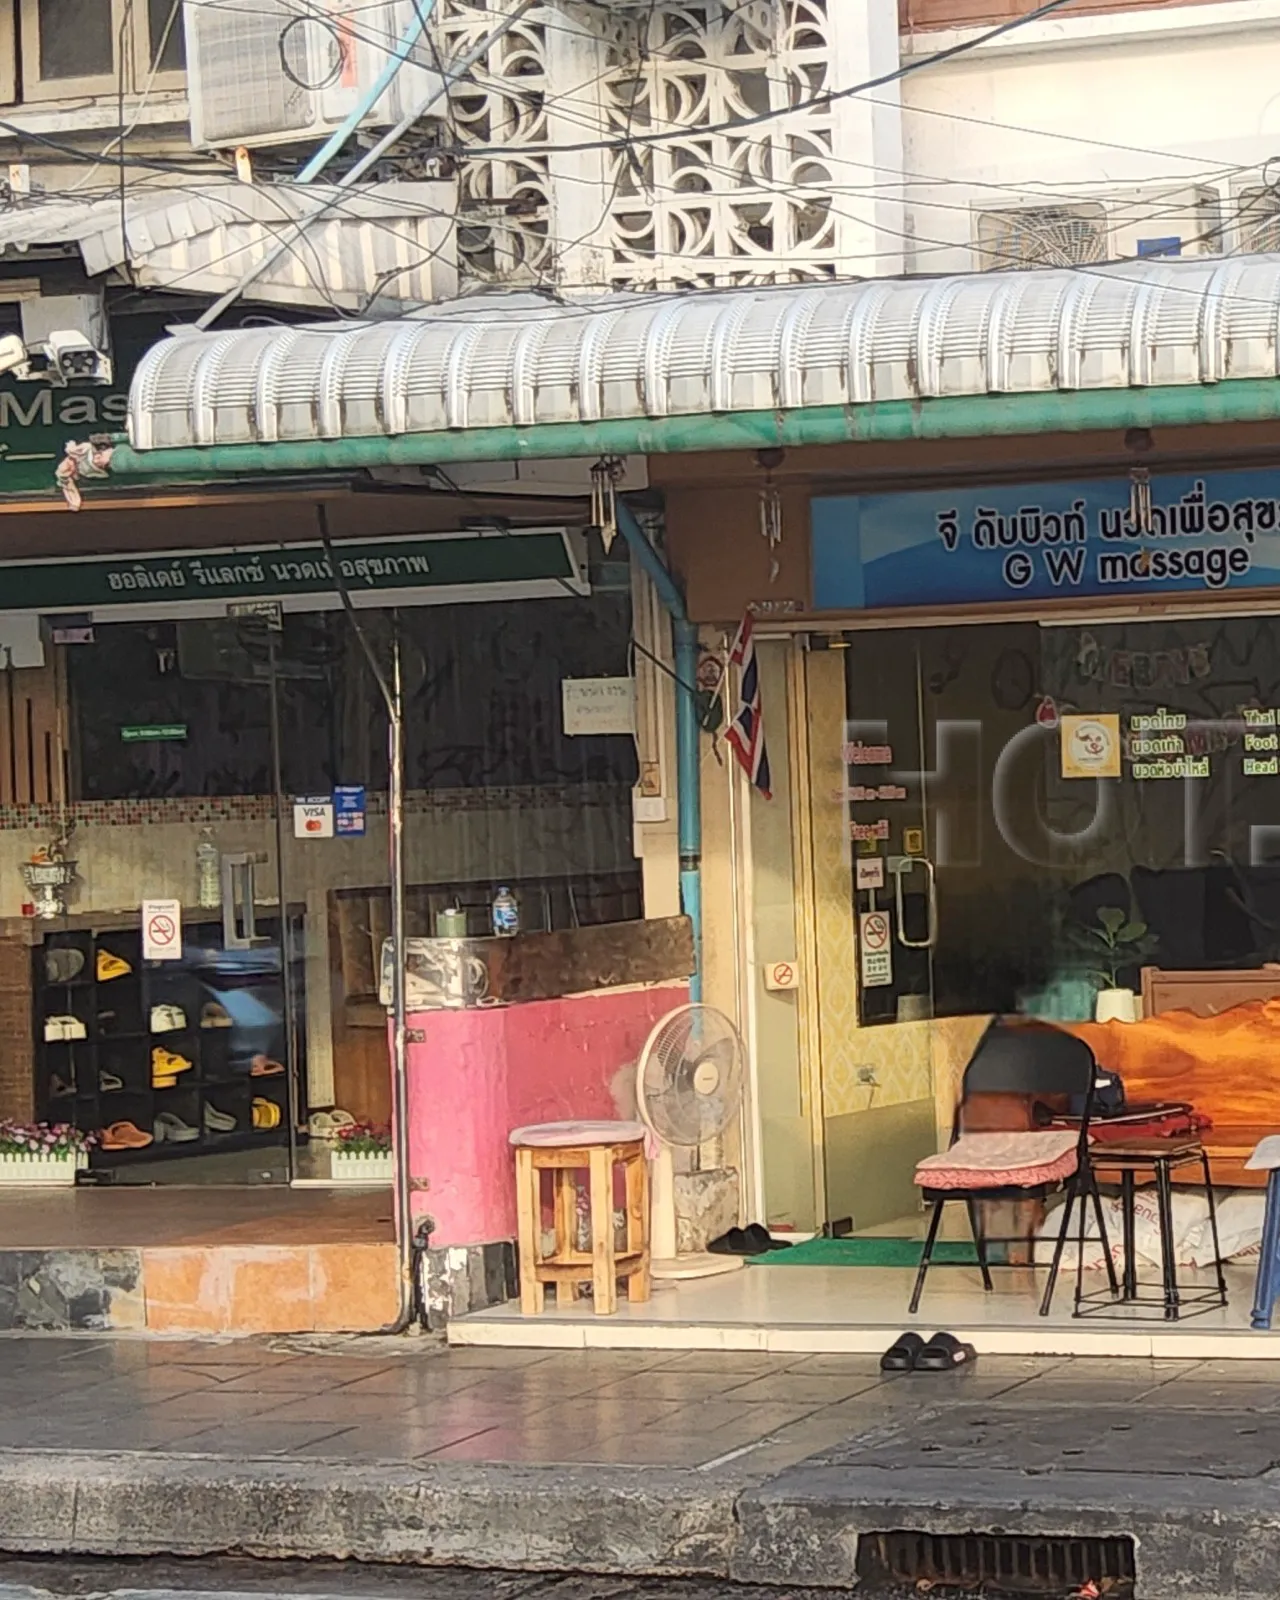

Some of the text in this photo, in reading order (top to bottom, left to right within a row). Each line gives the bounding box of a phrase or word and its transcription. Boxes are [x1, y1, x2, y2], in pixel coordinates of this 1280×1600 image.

[937, 511, 958, 551] จี
[270, 553, 430, 584] นวดเอสุขภาพ
[1003, 547, 1250, 588] G W massage
[1131, 708, 1186, 730] นวดไทย
[1244, 710, 1275, 726] Thai
[1245, 734, 1278, 751] Foot
[1244, 757, 1277, 775] Head
[303, 807, 325, 816] VISA
